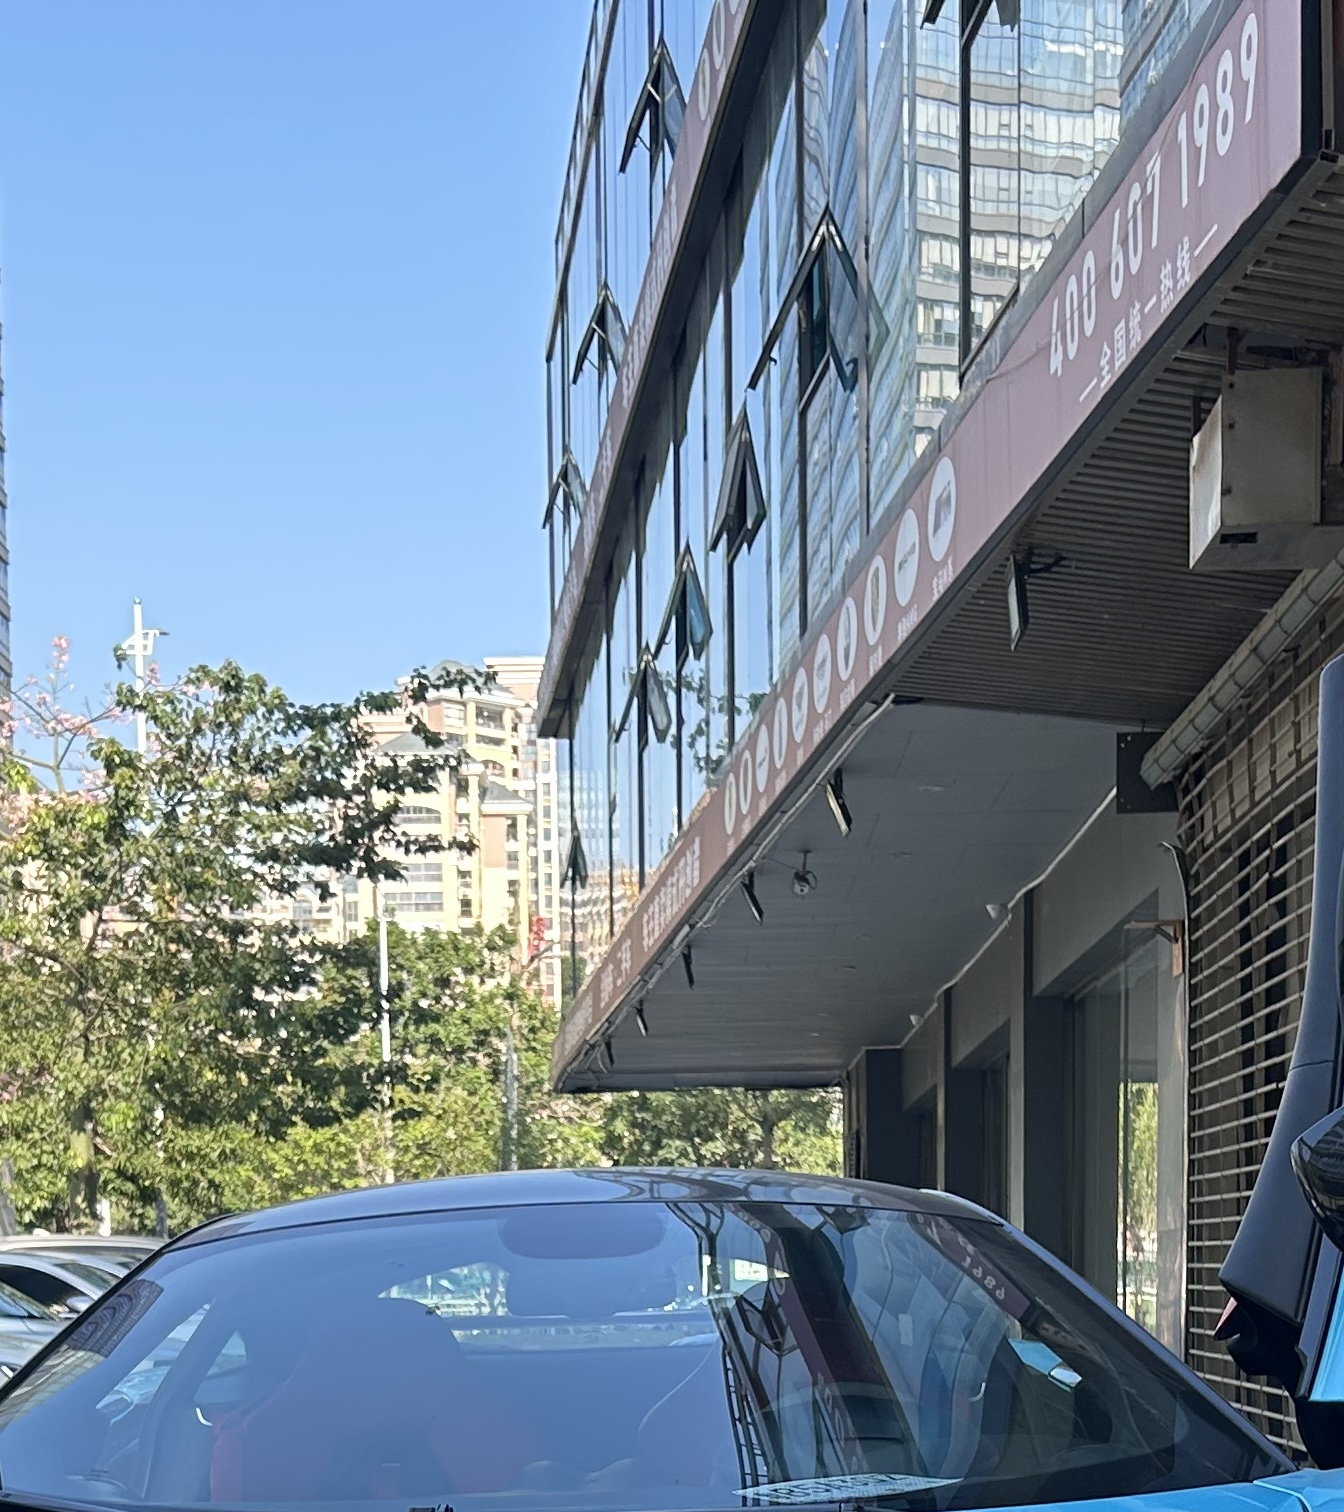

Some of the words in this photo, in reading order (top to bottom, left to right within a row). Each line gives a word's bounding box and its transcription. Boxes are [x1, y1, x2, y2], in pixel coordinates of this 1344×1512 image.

[1049, 250, 1097, 377] 400
[1110, 151, 1162, 301] 607
[1177, 12, 1259, 209] 1989
